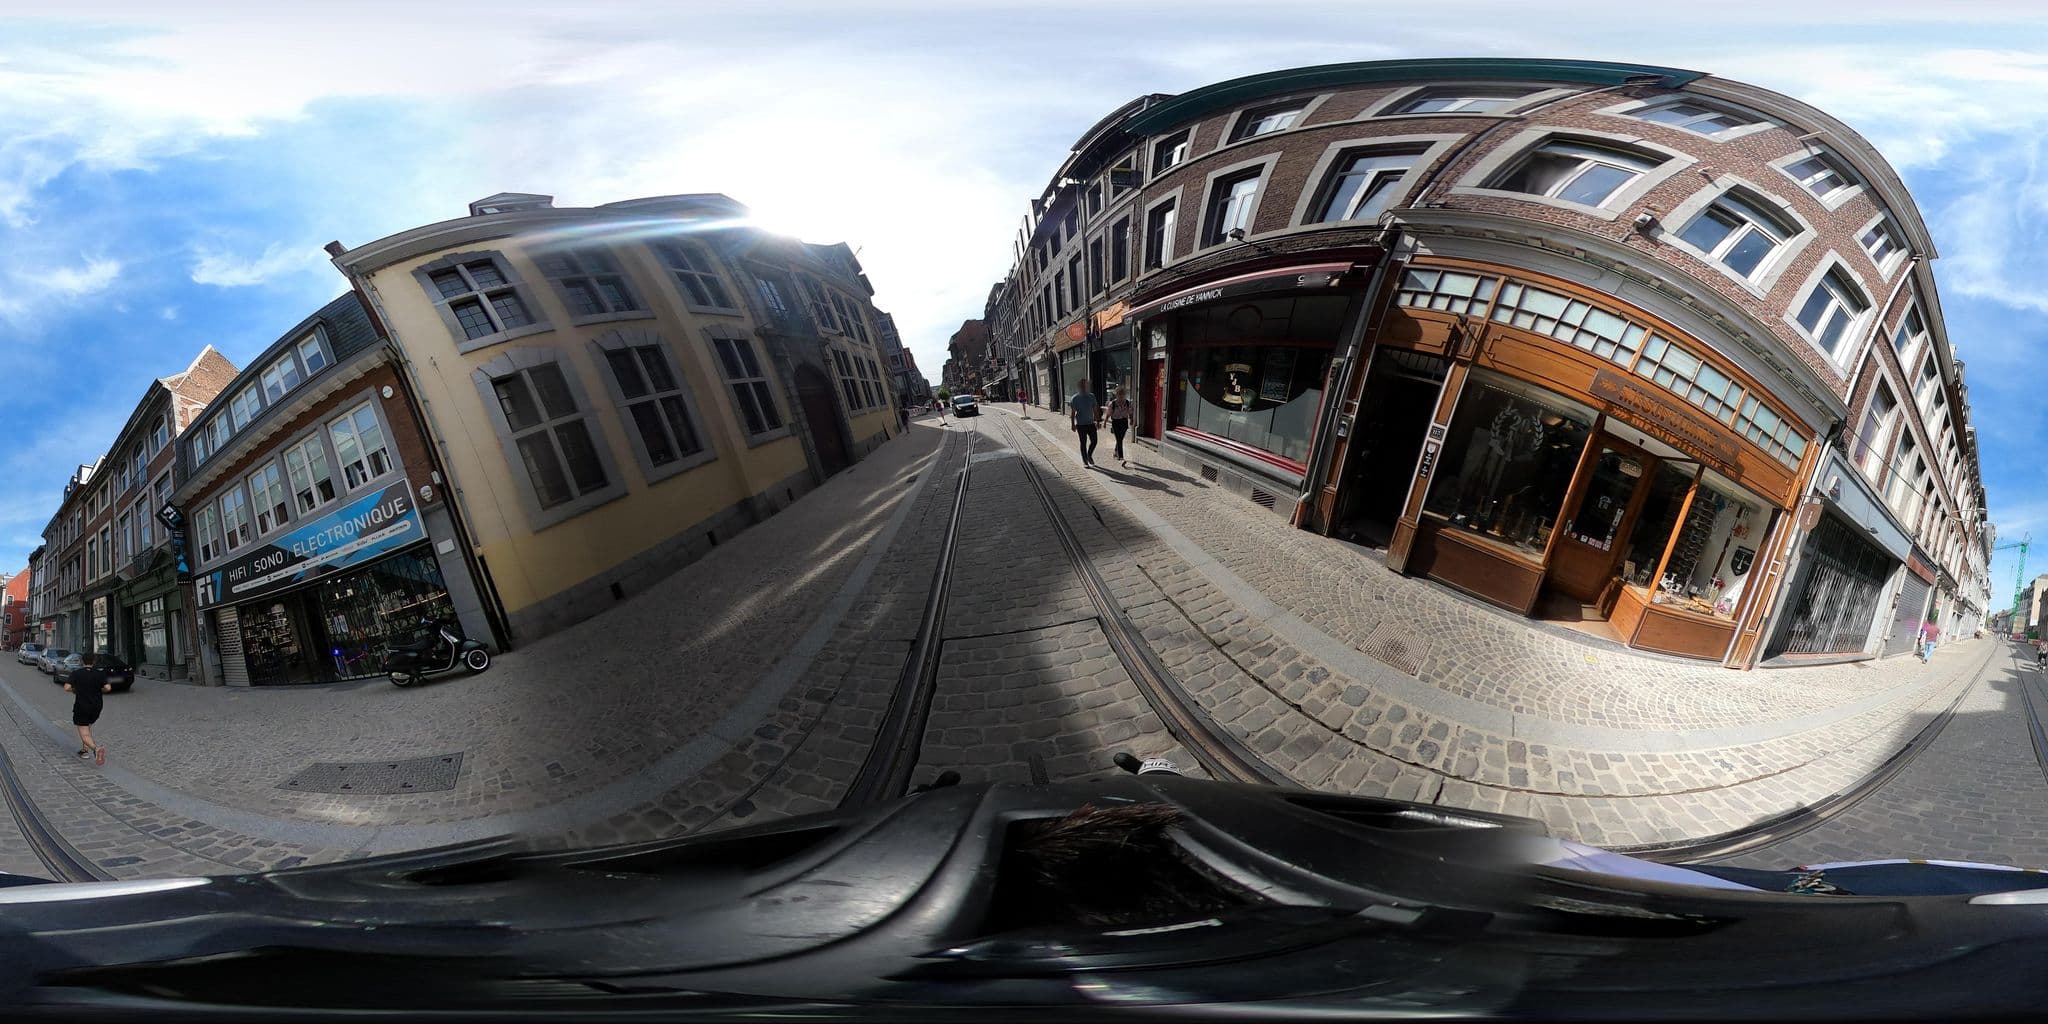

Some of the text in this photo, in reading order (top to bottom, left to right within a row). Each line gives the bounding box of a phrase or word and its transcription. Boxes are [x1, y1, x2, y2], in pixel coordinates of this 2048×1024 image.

[1160, 287, 1223, 312] LA CUISINE DE YANNICK
[228, 565, 247, 582] HIFI
[253, 551, 283, 573] SONO
[292, 496, 406, 557] ELECTRONIQUE
[196, 571, 223, 607] Fi7
